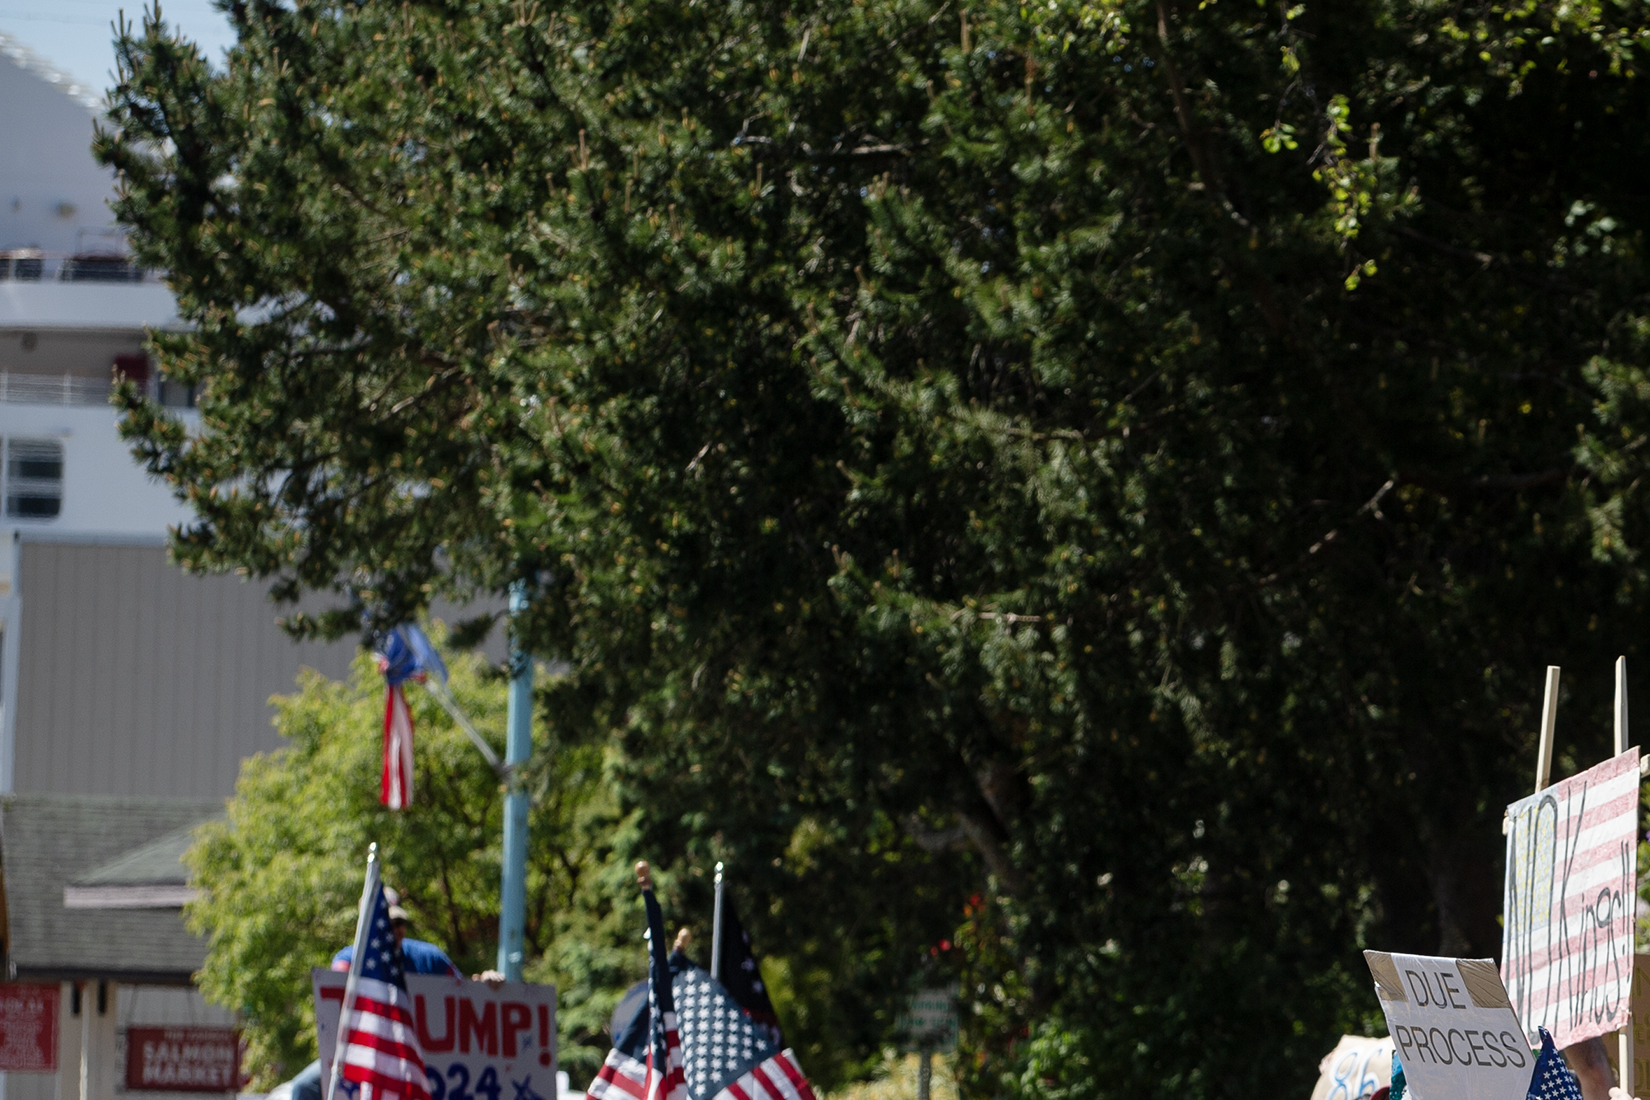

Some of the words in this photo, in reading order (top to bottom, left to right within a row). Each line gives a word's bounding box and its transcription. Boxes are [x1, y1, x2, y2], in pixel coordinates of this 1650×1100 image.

[1405, 970, 1466, 1009] DUE
[320, 985, 552, 1066] UMP!
[1395, 1024, 1526, 1069] PROCESS
